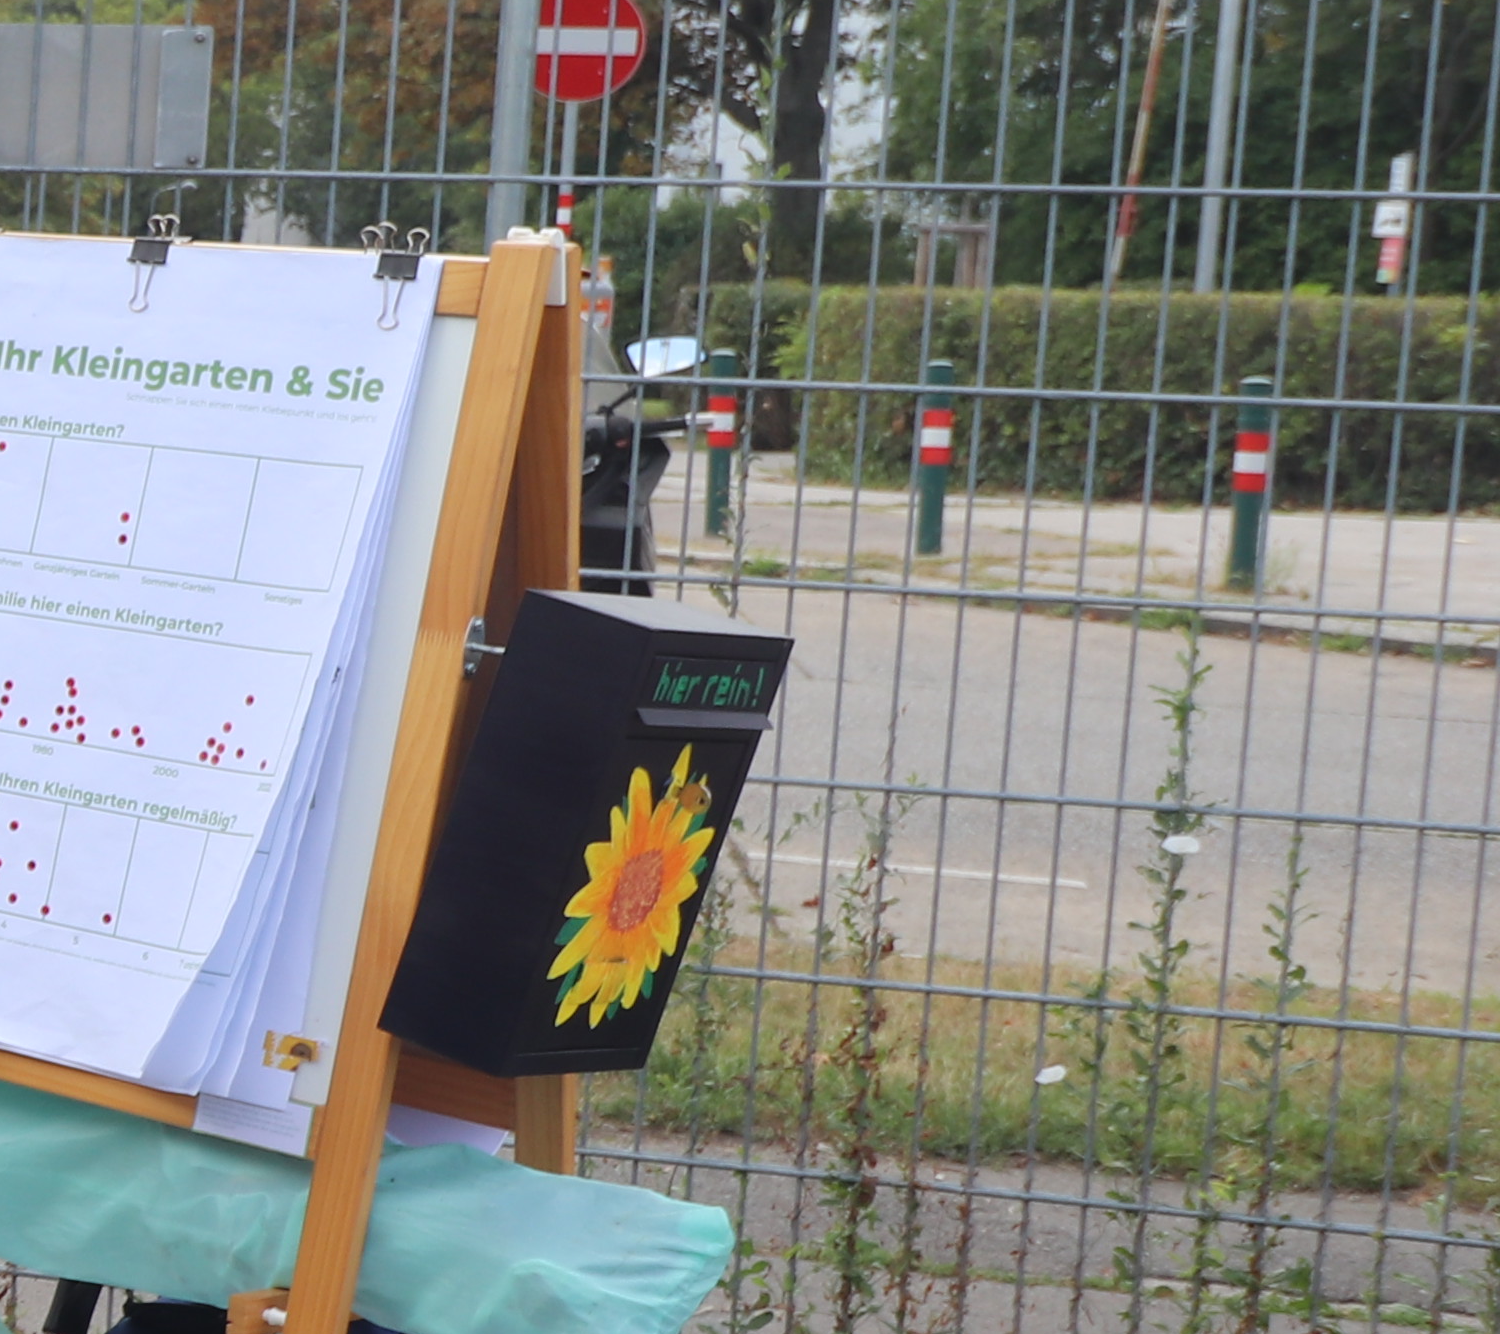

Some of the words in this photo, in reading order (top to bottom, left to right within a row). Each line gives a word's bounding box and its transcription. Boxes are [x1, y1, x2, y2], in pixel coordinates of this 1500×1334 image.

[51, 345, 273, 393] Kleingarten
[285, 365, 313, 396] &
[325, 368, 385, 403] Sie
[22, 415, 125, 440] Kleingarten?
[33, 561, 89, 579] Ganzjähriges
[30, 594, 62, 614] hier
[65, 601, 111, 621] einen
[113, 607, 224, 637] Kleingarten?
[652, 661, 702, 704] hier
[701, 663, 765, 708] rein!
[32, 743, 54, 756] 1980
[151, 764, 179, 779] 2000
[43, 777, 138, 812] Kleingarten
[141, 797, 239, 831] regelmäßig?
[0, 920, 7, 929] 4
[72, 936, 79, 945] 5
[141, 951, 149, 961] 6
